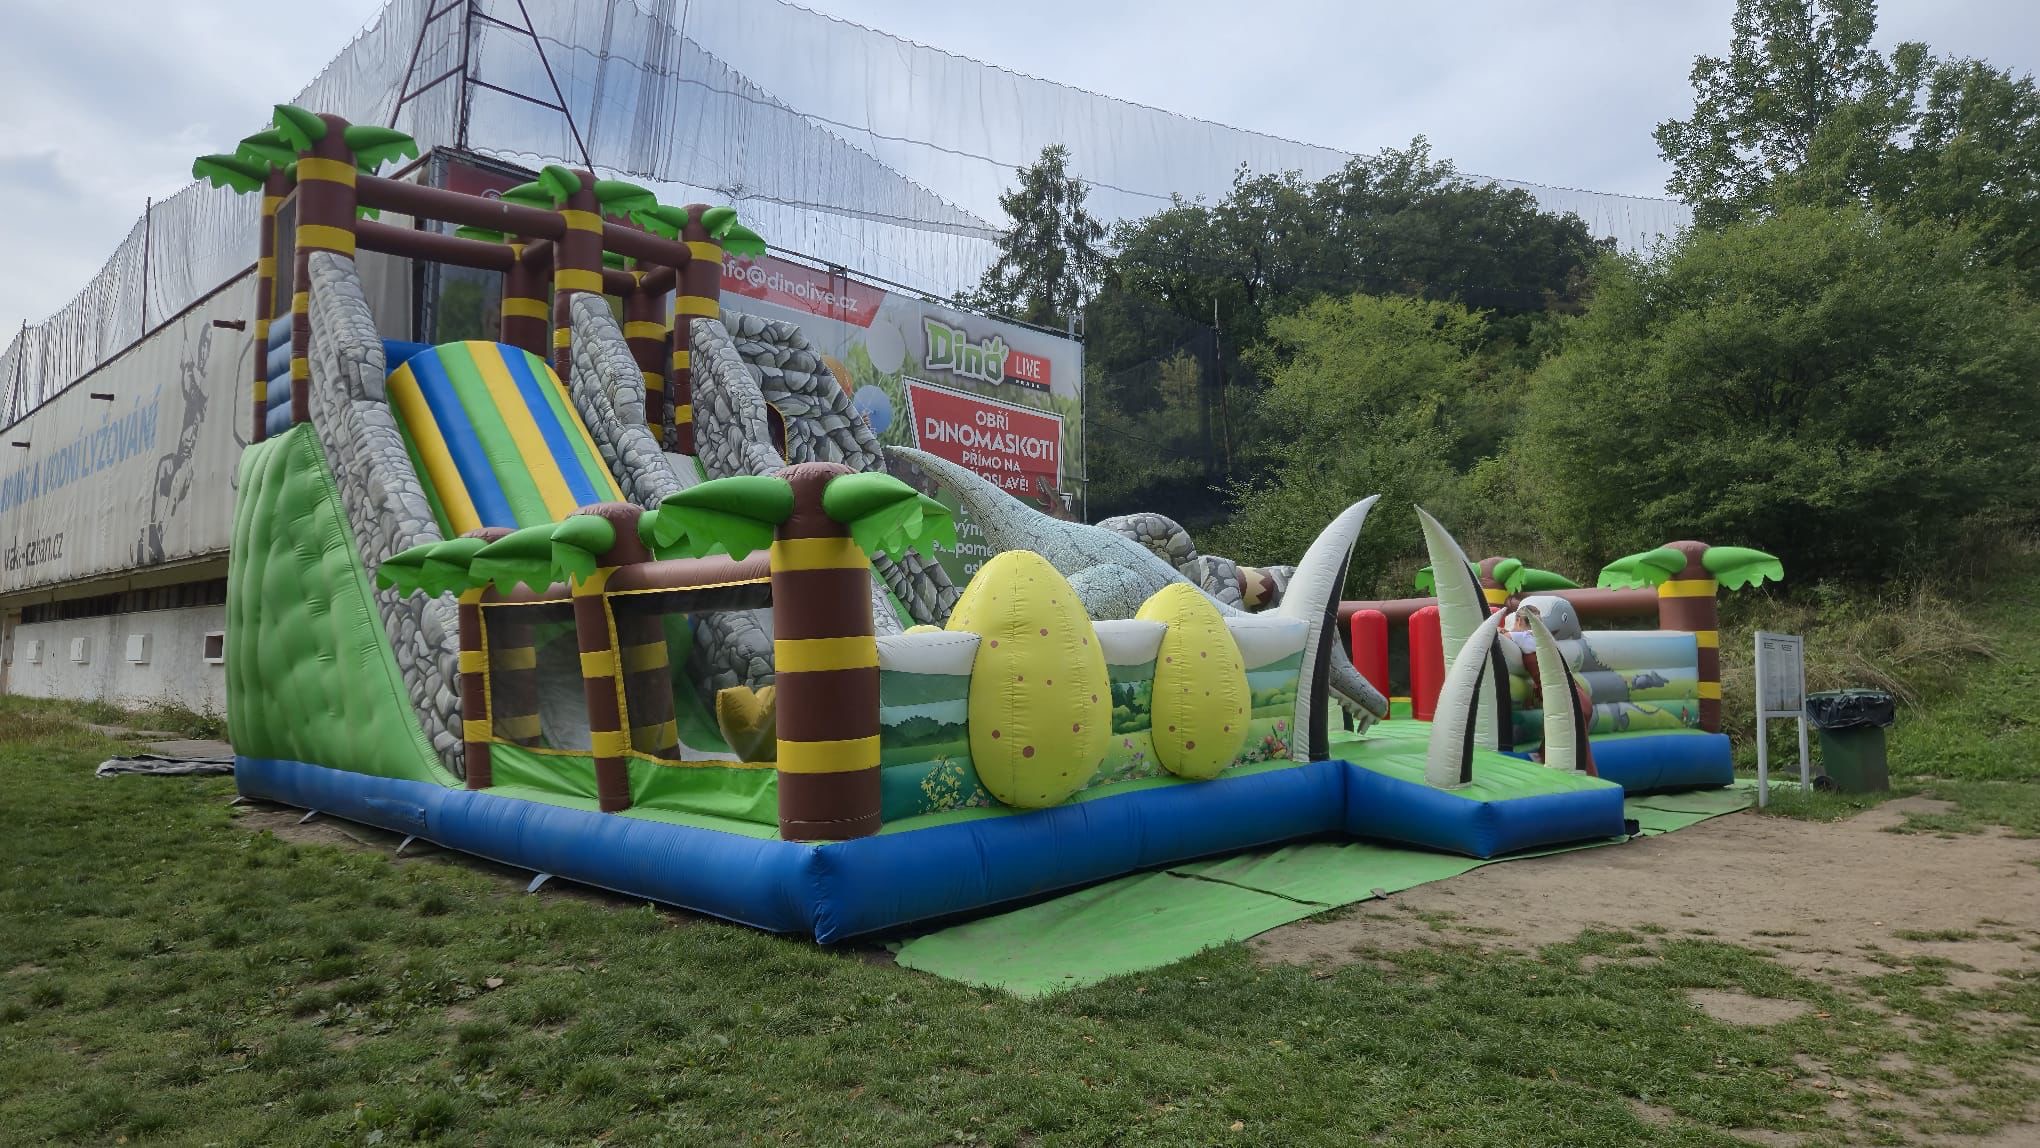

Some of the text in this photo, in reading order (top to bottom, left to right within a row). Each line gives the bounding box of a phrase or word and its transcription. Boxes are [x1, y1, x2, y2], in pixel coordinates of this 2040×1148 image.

[721, 260, 857, 311] nfo@dinolive.cz
[924, 317, 1040, 385] Dino LIVE
[925, 417, 1054, 462] DINOMASKOTI
[975, 410, 1009, 431] OBŘÍ
[962, 449, 1022, 473] PŘÍMO NA
